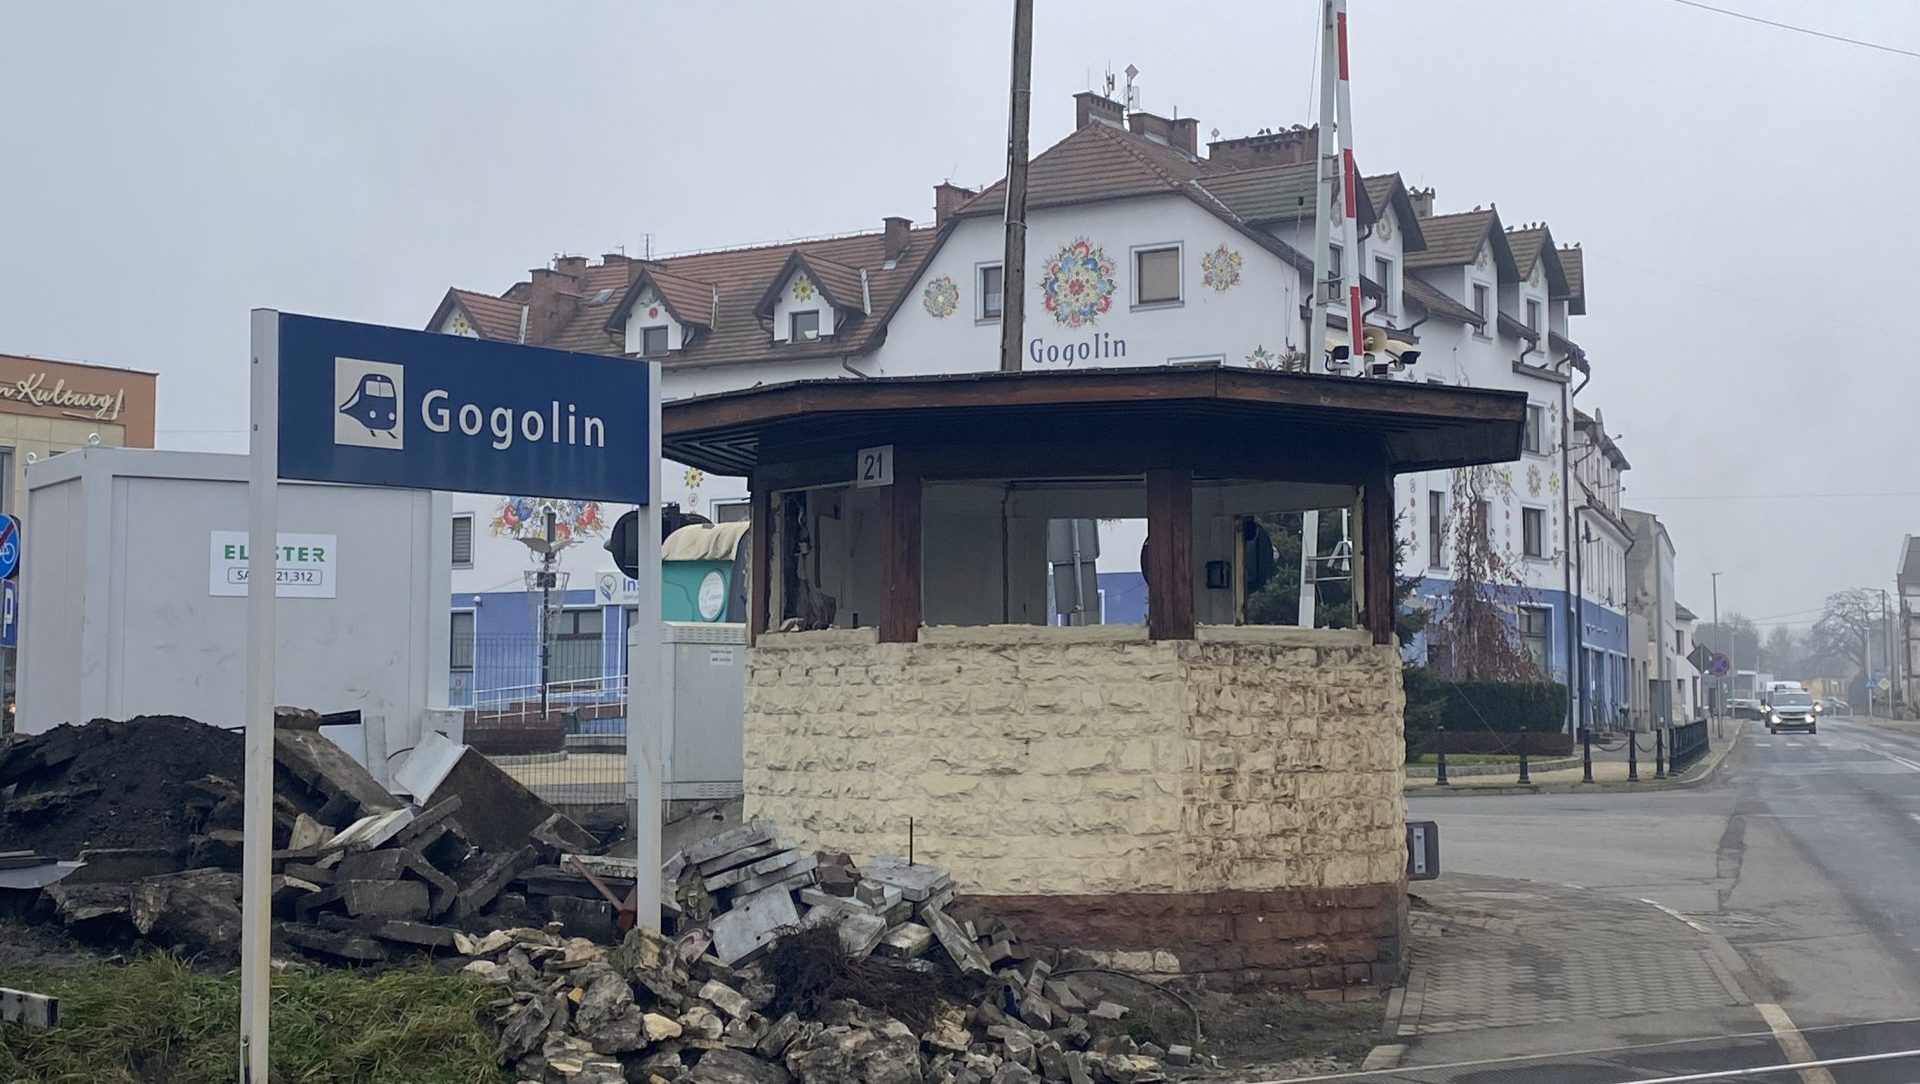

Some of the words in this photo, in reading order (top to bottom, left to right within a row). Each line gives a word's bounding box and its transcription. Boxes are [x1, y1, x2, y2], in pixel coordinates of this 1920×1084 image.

[1029, 332, 1126, 367] Gogolin
[421, 389, 605, 450] Gogolin
[863, 452, 882, 480] 21
